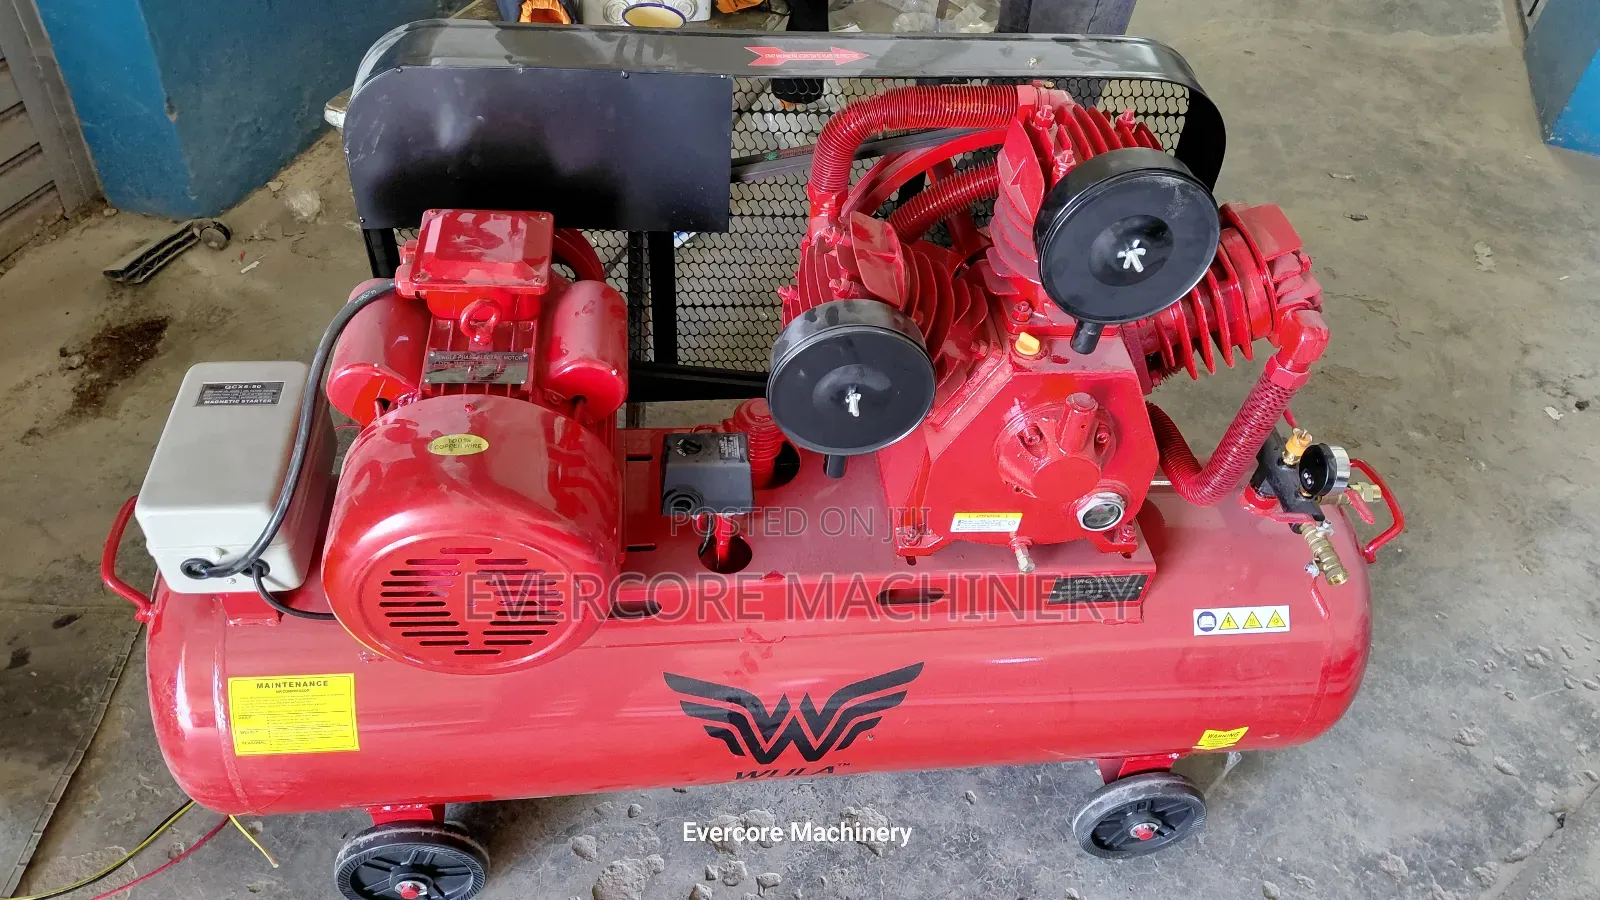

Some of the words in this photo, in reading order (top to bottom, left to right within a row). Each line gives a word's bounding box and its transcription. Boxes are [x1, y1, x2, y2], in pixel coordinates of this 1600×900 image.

[434, 443, 462, 451] COPPER
[256, 680, 329, 689] MAINTENANCE
[1207, 731, 1240, 739] WARNING
